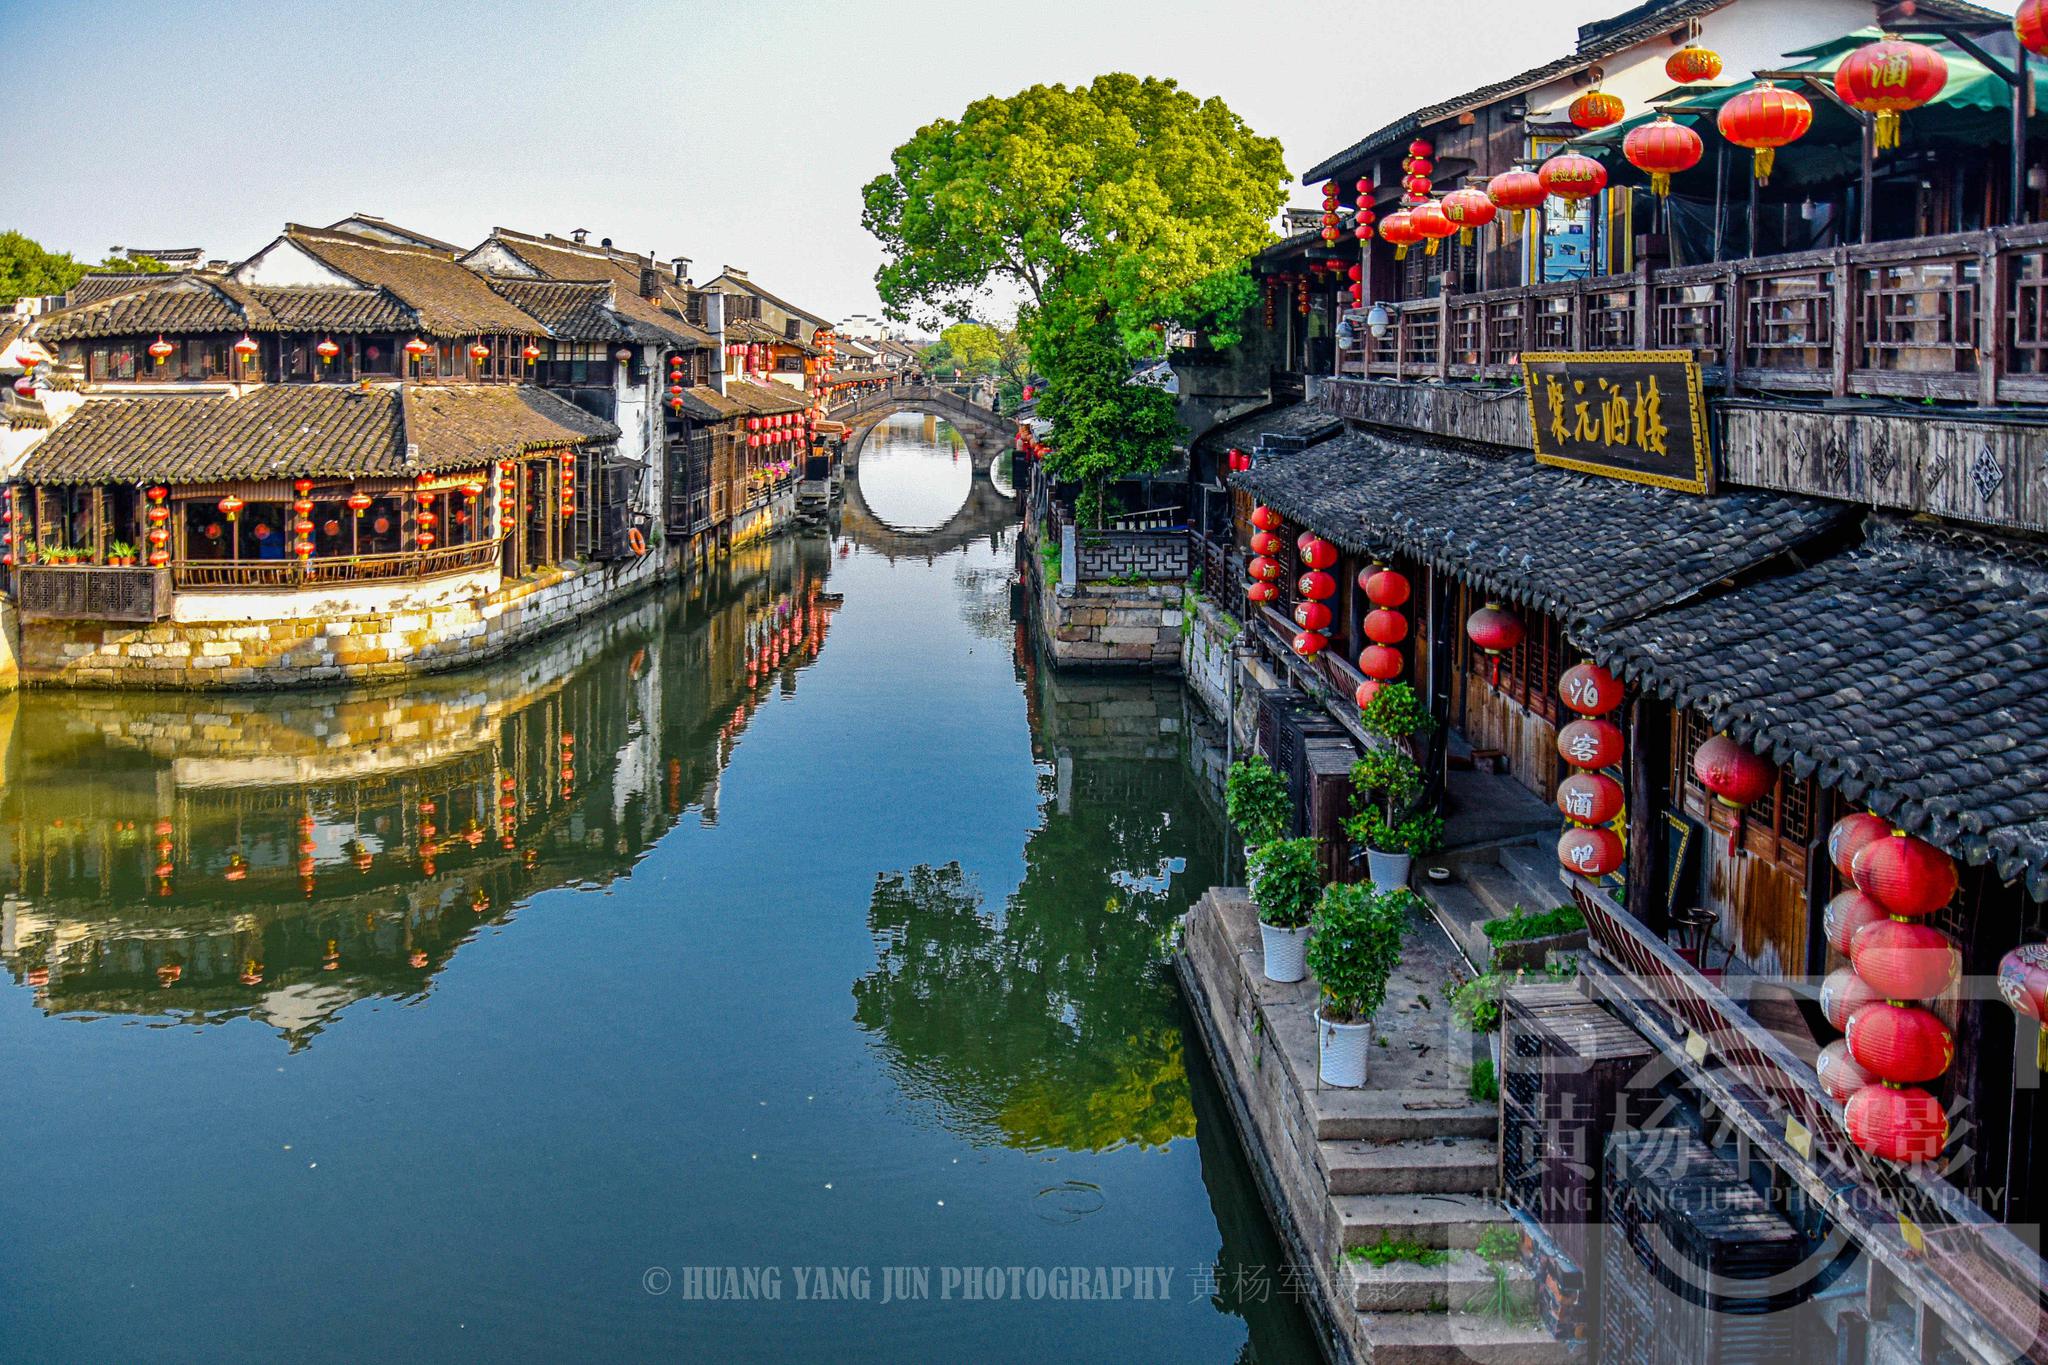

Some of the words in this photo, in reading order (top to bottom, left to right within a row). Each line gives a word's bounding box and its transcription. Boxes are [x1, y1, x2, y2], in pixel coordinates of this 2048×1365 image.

[1870, 50, 1909, 88] 酒
[1565, 678, 1600, 873] 泊客酒吧
